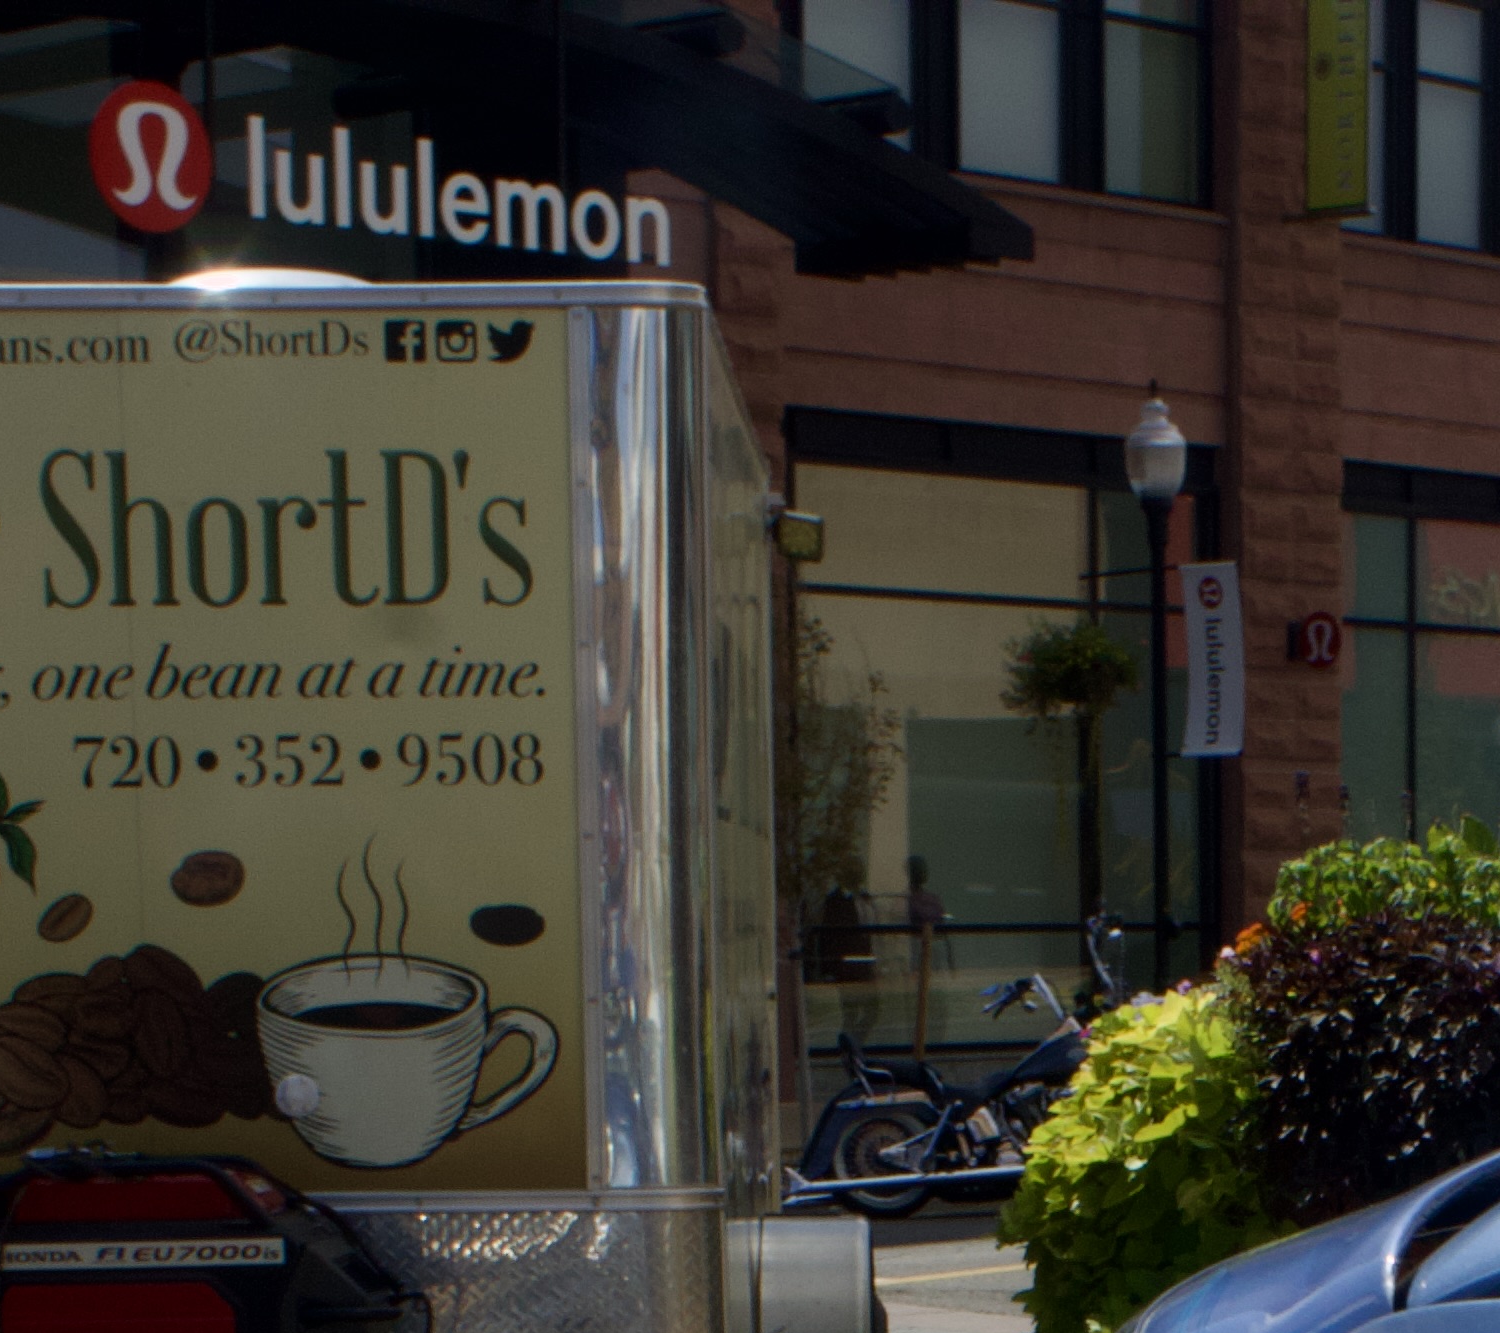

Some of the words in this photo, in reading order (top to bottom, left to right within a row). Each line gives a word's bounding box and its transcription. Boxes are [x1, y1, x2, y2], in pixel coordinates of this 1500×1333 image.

[247, 114, 671, 267] lululemon
[174, 318, 369, 364] @ShortDs
[38, 447, 535, 609] ShortD's
[32, 659, 134, 700] one
[146, 644, 280, 701] bean
[297, 655, 357, 699] at
[368, 660, 403, 699] a
[418, 647, 546, 700] time.
[1204, 618, 1226, 746] lululemon
